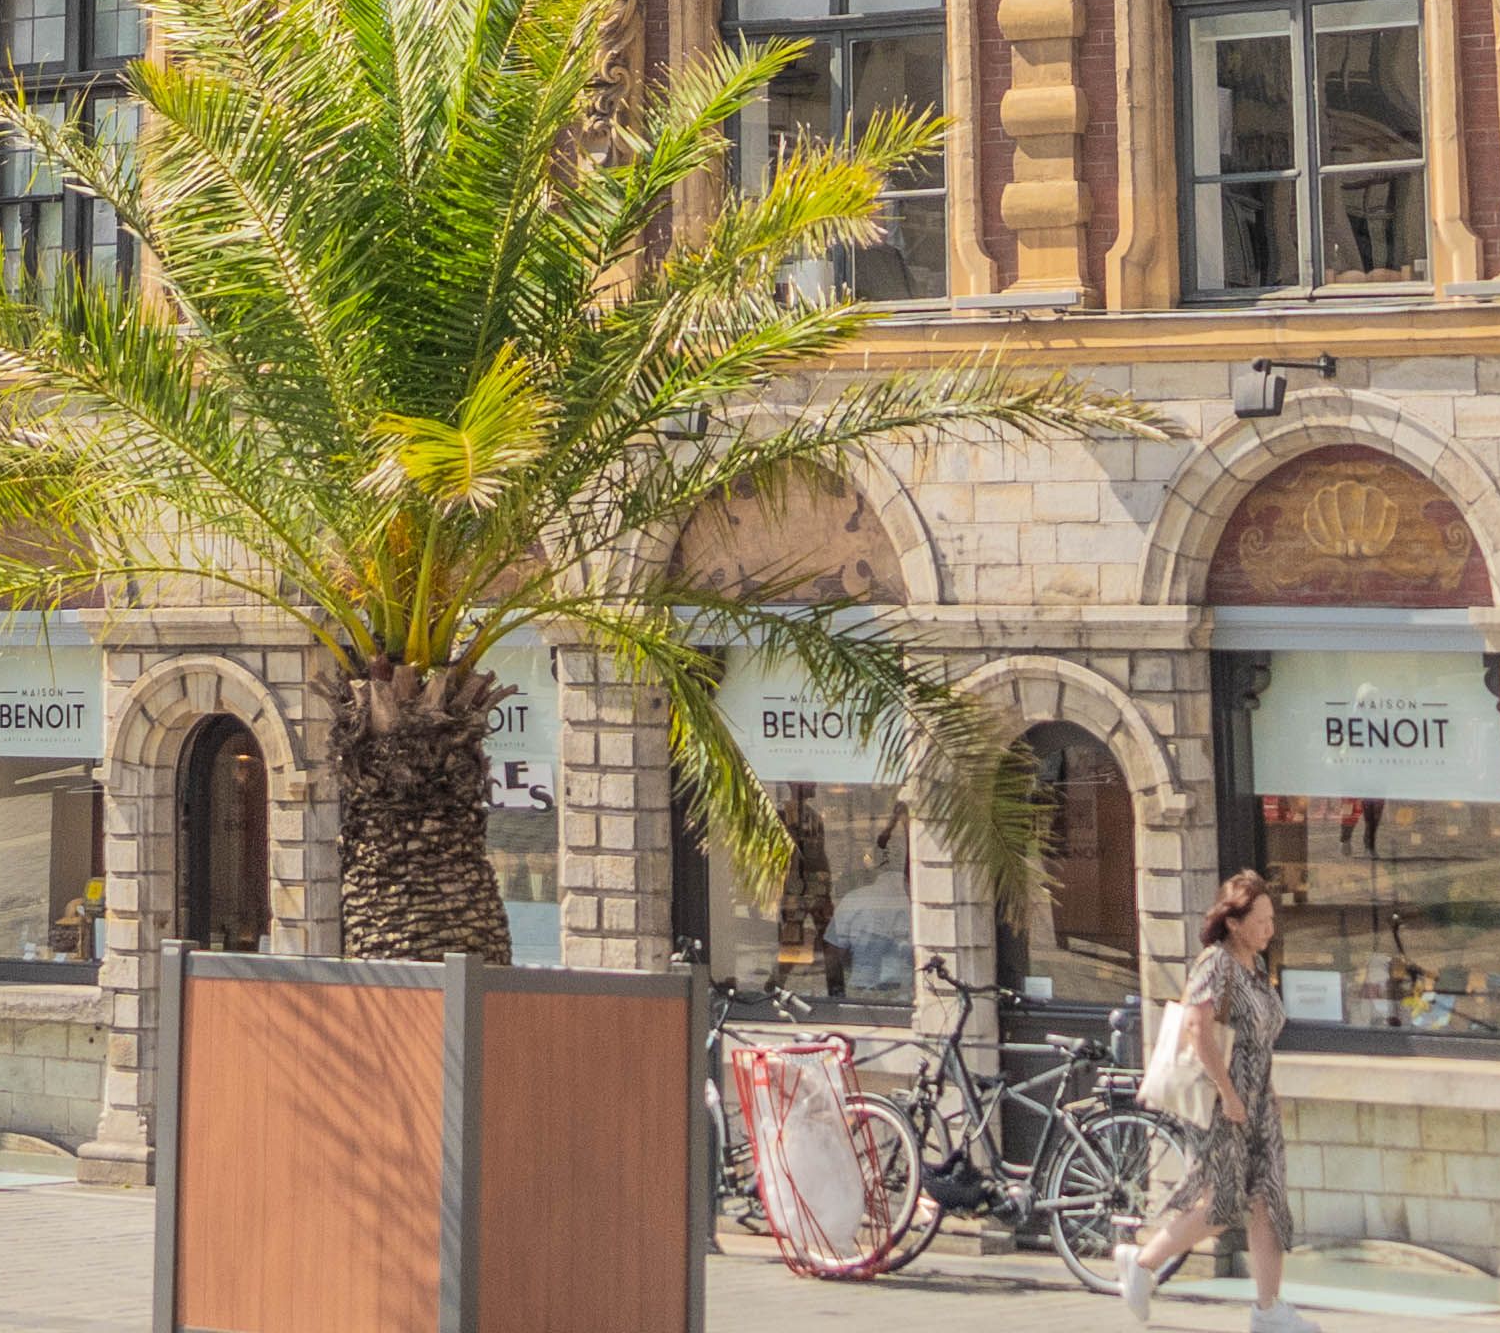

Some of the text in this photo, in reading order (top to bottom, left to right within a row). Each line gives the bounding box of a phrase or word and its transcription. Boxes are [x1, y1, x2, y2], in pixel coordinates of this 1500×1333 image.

[22, 688, 63, 697] MAISON
[1358, 699, 1418, 710] MAISON
[0, 703, 85, 729] BENOIT
[487, 706, 528, 733] OIT
[1326, 717, 1449, 748] BENOIT
